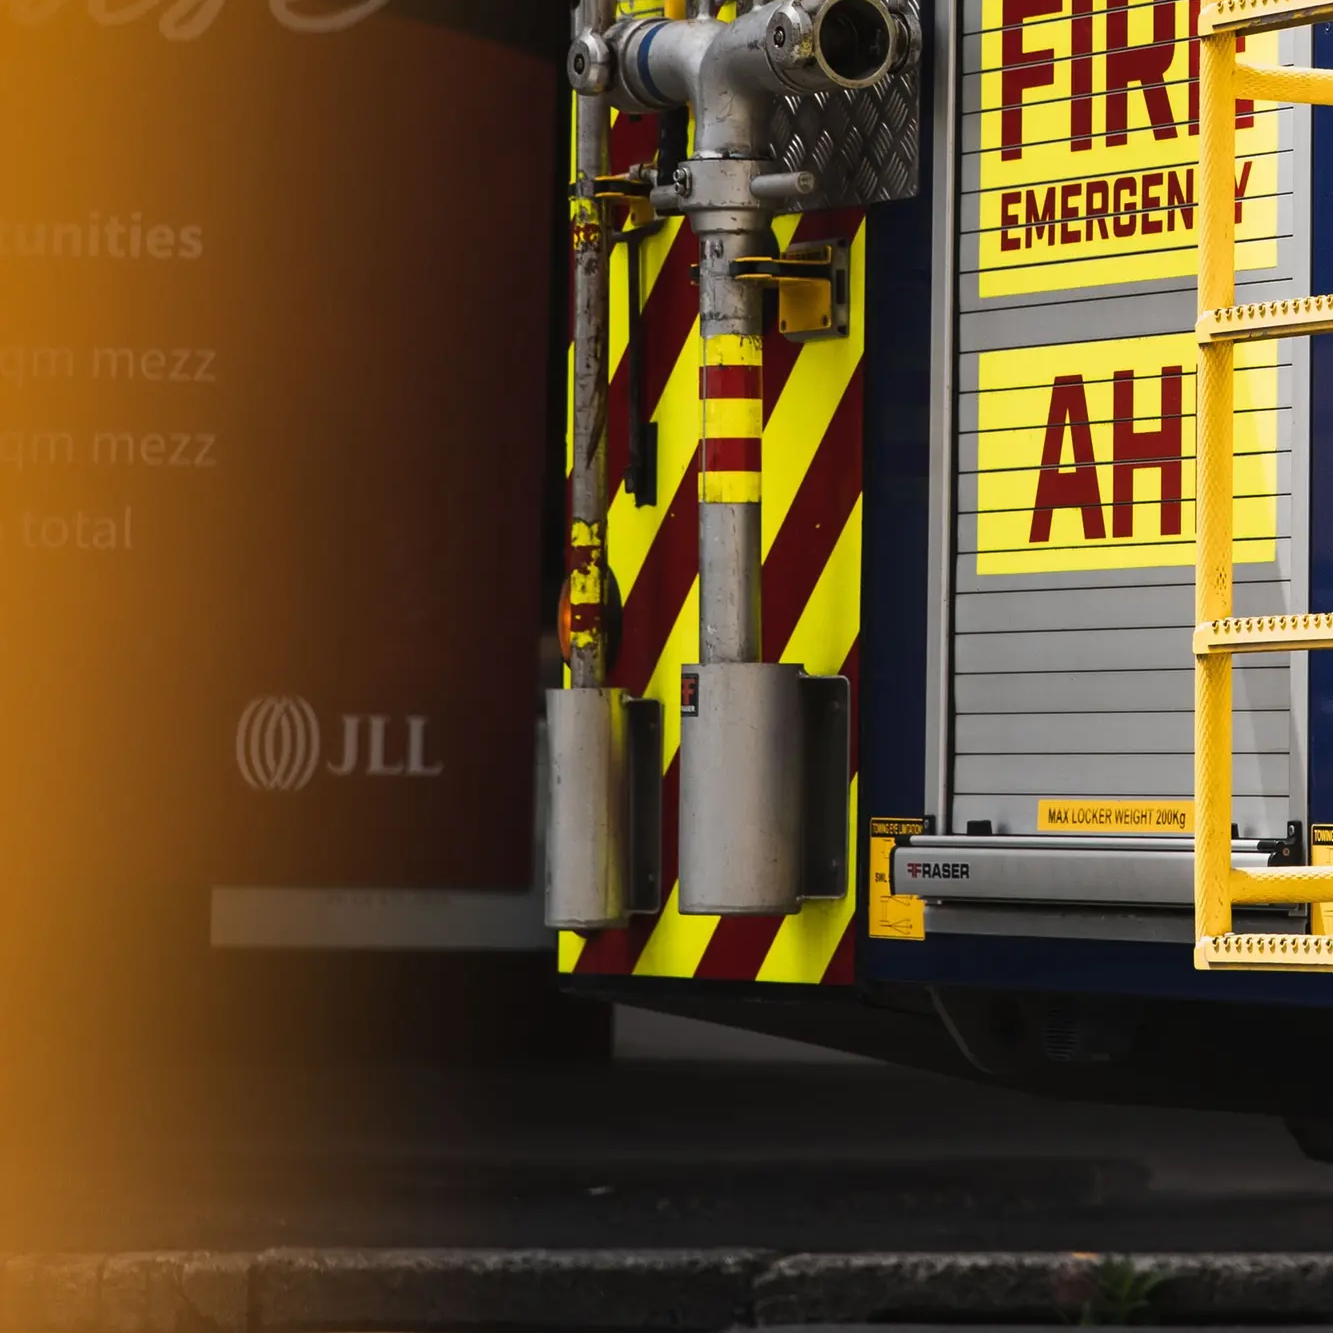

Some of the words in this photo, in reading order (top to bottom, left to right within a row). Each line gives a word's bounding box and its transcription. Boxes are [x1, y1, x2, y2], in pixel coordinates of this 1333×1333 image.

[1001, 160, 1253, 253] EMERGENY
[91, 344, 218, 383] mezz
[91, 429, 218, 468] mezz
[1029, 365, 1198, 543] AH
[21, 504, 134, 551] total
[326, 714, 444, 776] JLL
[1048, 807, 1069, 825] MAX
[1072, 808, 1113, 825] LOCKER
[1115, 808, 1154, 826] WEIGHT
[1155, 808, 1187, 830] 200Kg
[907, 862, 970, 879] FRASER
